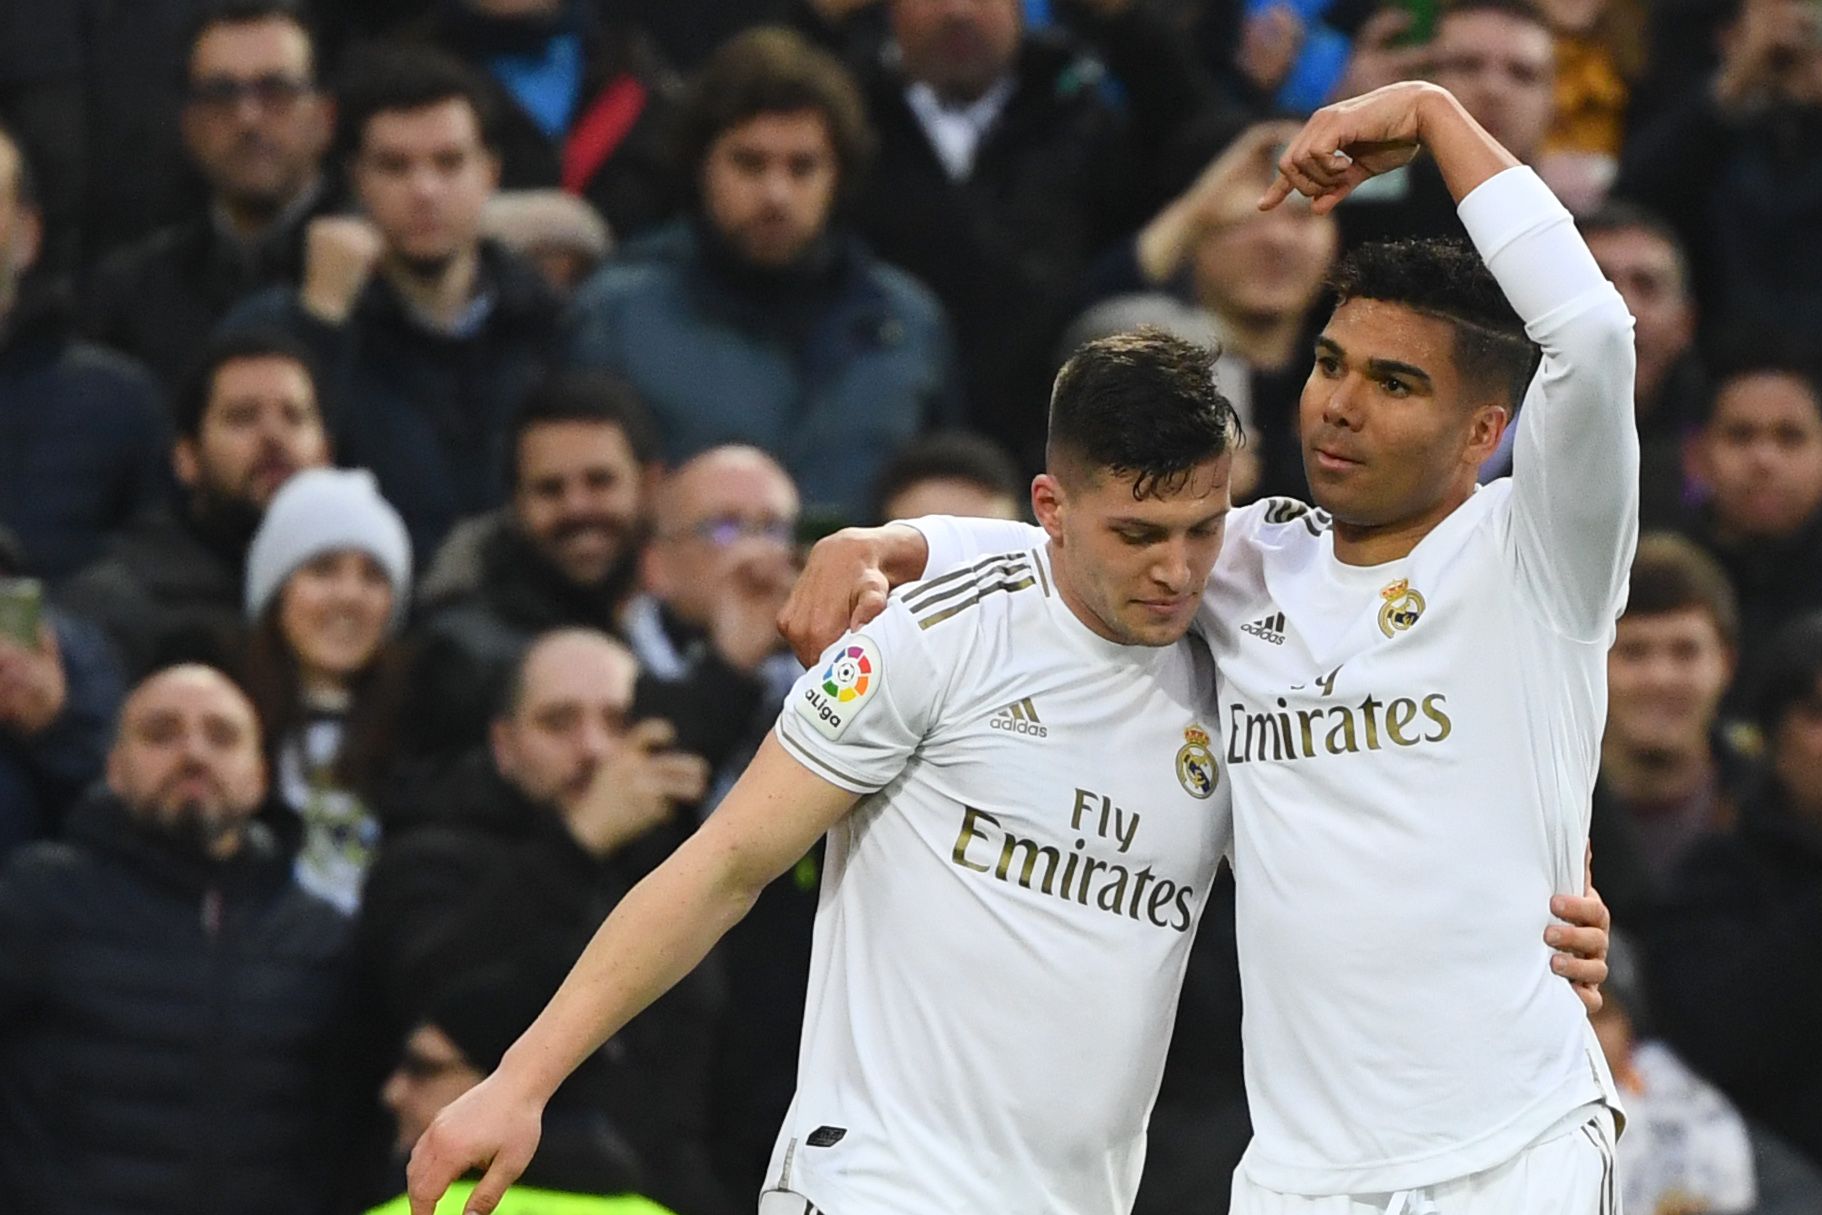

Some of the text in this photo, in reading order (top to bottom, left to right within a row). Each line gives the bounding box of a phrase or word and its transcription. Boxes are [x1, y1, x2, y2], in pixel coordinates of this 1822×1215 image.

[1240, 623, 1286, 646] adidas
[804, 688, 842, 729] aLiga
[989, 717, 1048, 738] adidas
[1227, 692, 1452, 764] Emirates
[1071, 787, 1140, 853] Fly
[952, 803, 1194, 933] Emirates
